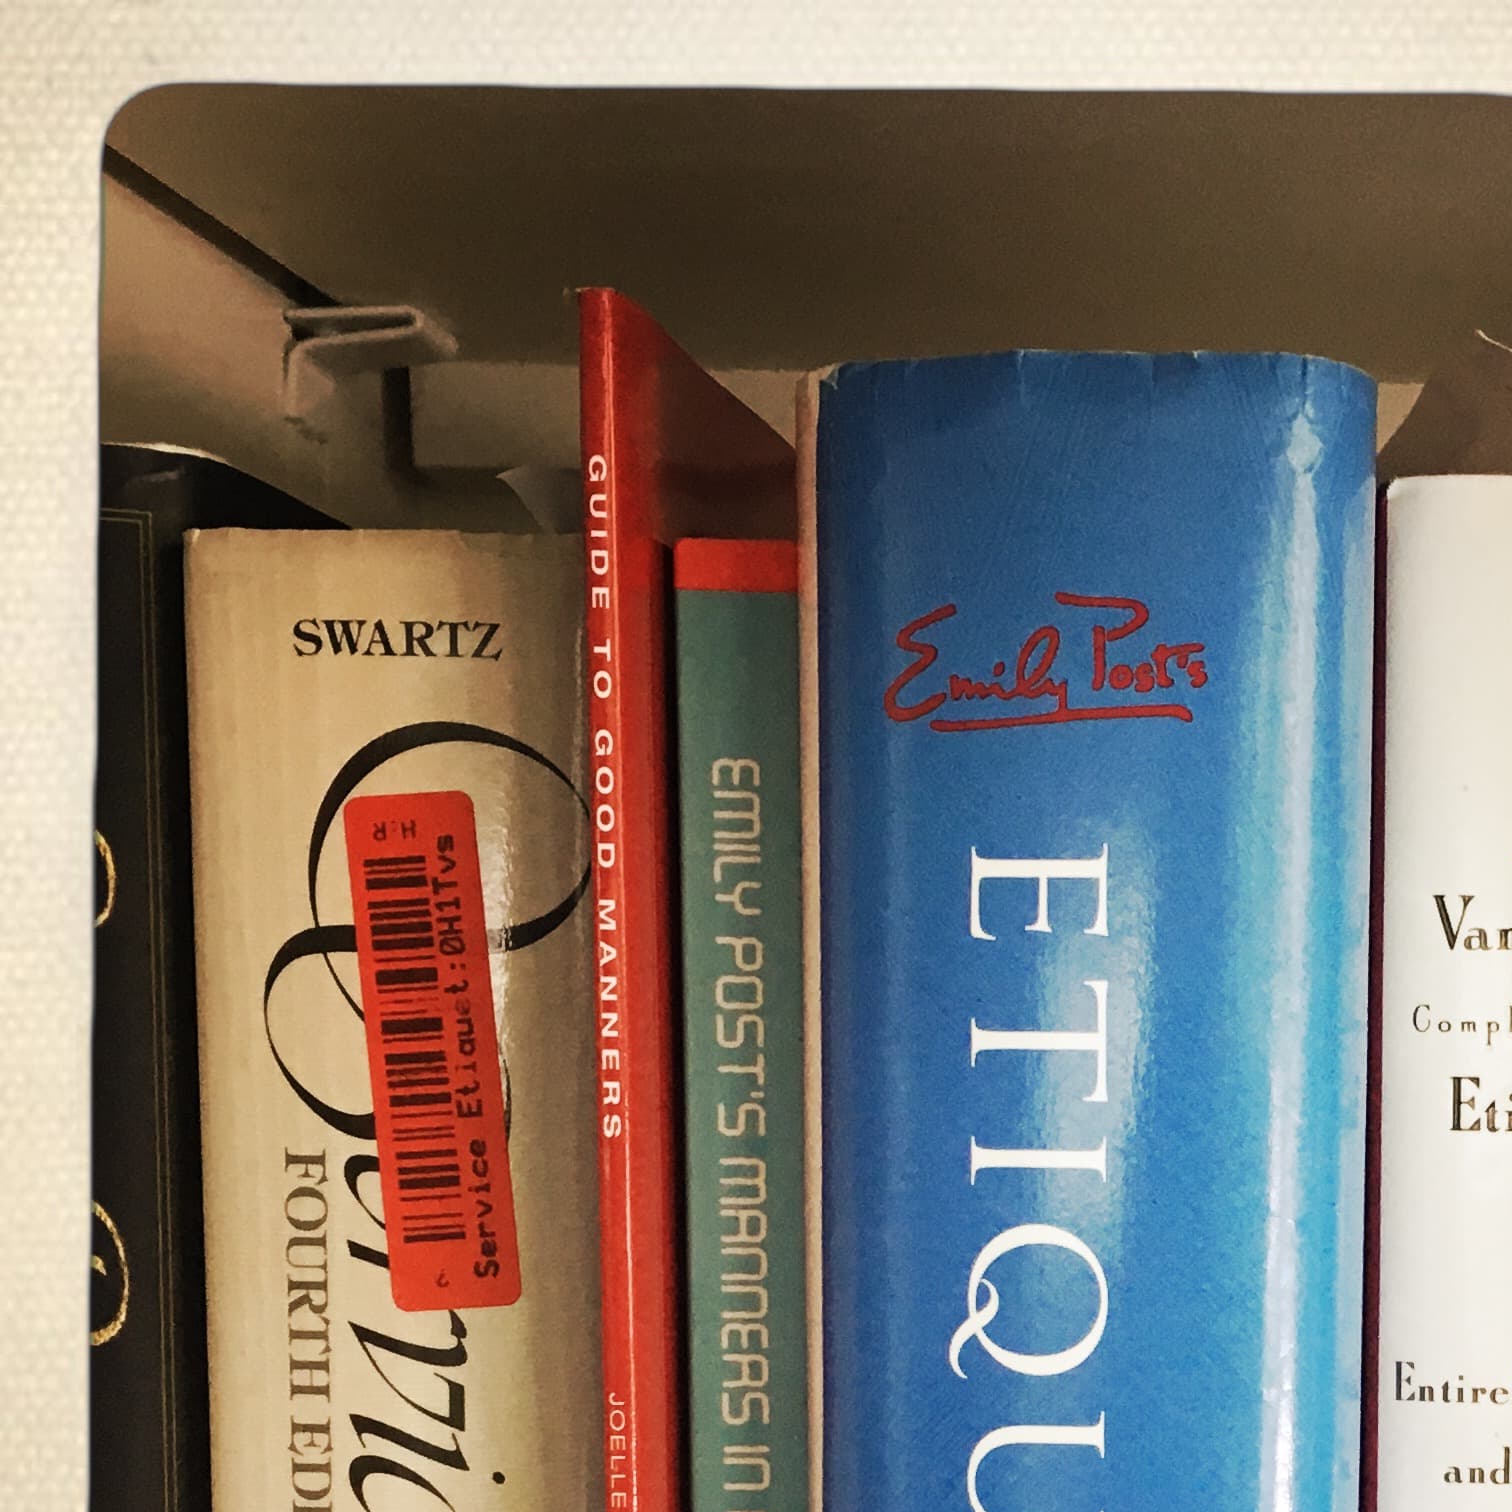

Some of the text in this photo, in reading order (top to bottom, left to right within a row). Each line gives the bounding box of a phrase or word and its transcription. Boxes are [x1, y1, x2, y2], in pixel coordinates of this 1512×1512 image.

[293, 618, 504, 661] SWARTZ
[884, 603, 1070, 722] Emily
[588, 454, 623, 1139] GUIDE TO GOOD MANNERS
[711, 757, 763, 918] EMILY
[714, 936, 767, 1138] POST'S
[283, 1146, 334, 1404] FOURTH
[468, 1138, 500, 1279] Service
[717, 1157, 771, 1425] MANNERS
[608, 1392, 627, 1509] JOELLE
[722, 1444, 771, 1492] IN
[1442, 1446, 1511, 1486] and
